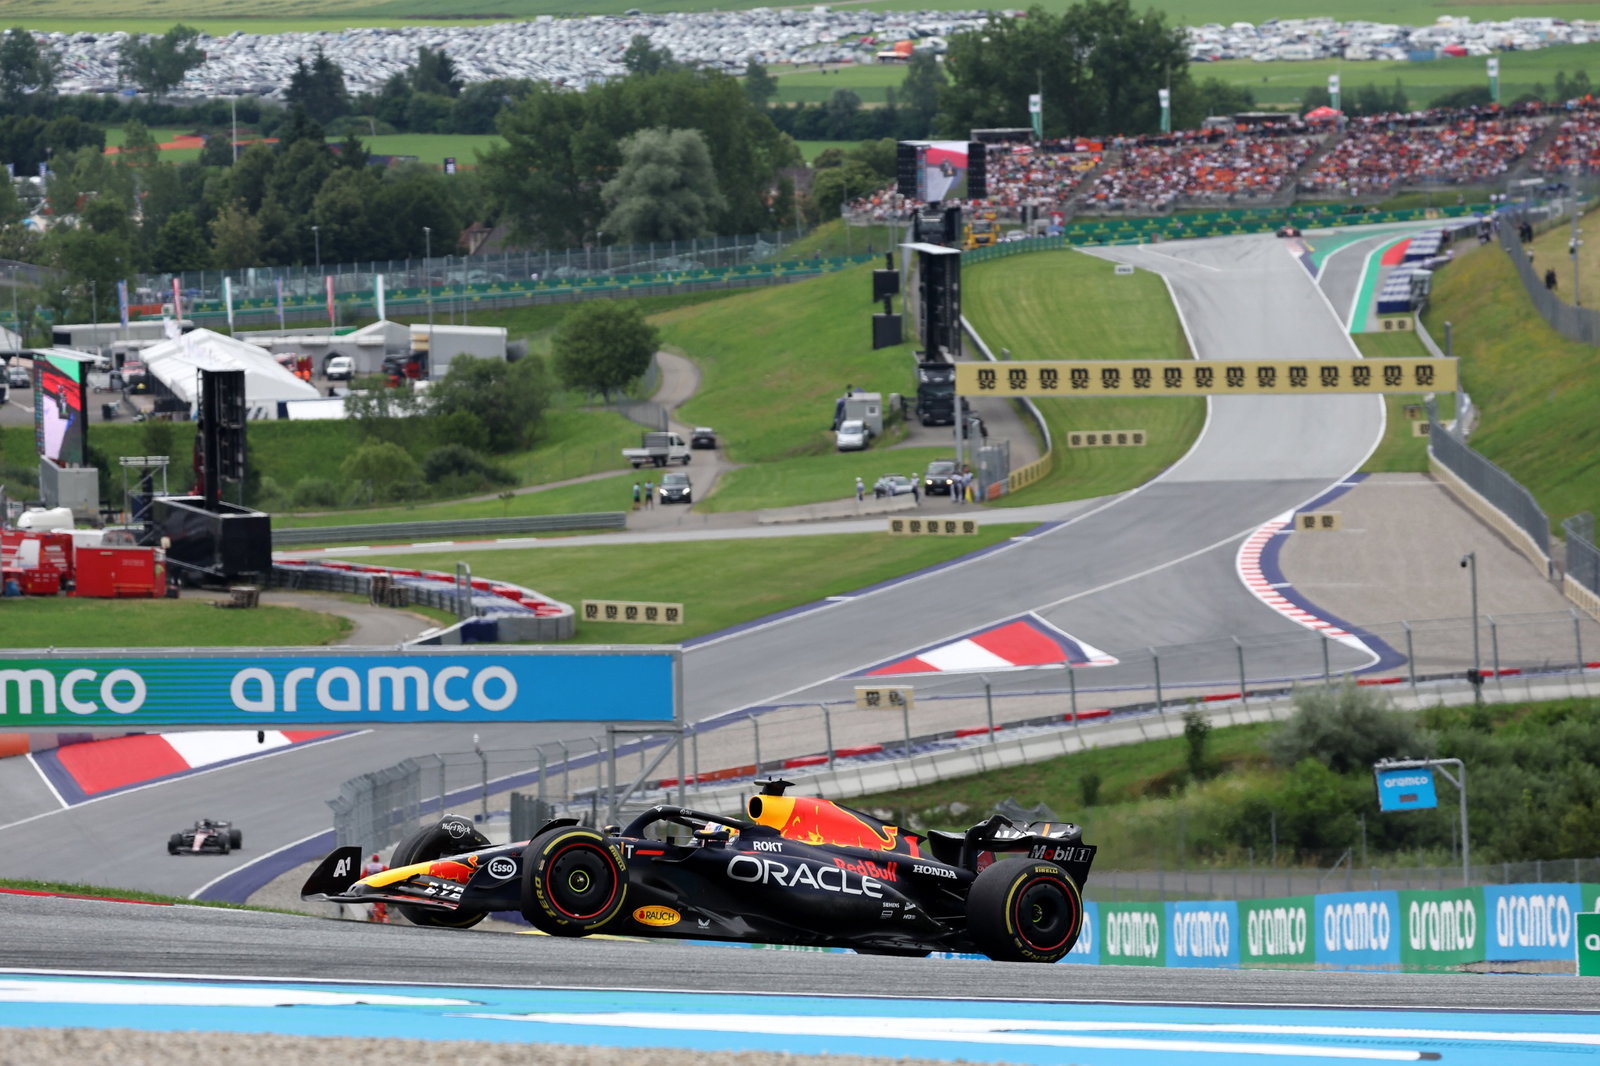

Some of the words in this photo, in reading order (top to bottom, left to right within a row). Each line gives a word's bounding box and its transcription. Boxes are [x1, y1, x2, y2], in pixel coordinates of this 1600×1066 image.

[230, 666, 518, 712] aramco
[492, 862, 513, 872] Esso
[753, 841, 782, 852] ROKT
[1031, 845, 1075, 861] Mobil
[727, 855, 883, 899] ORACLE
[912, 864, 958, 880] HONDA
[645, 912, 675, 921] RAUCH
[1107, 912, 1159, 957] aramco
[1174, 911, 1230, 957] aramco
[1248, 907, 1306, 956] aramco
[1325, 902, 1390, 952] aramco
[1409, 899, 1476, 951] aramco
[1497, 895, 1570, 948] aramco
